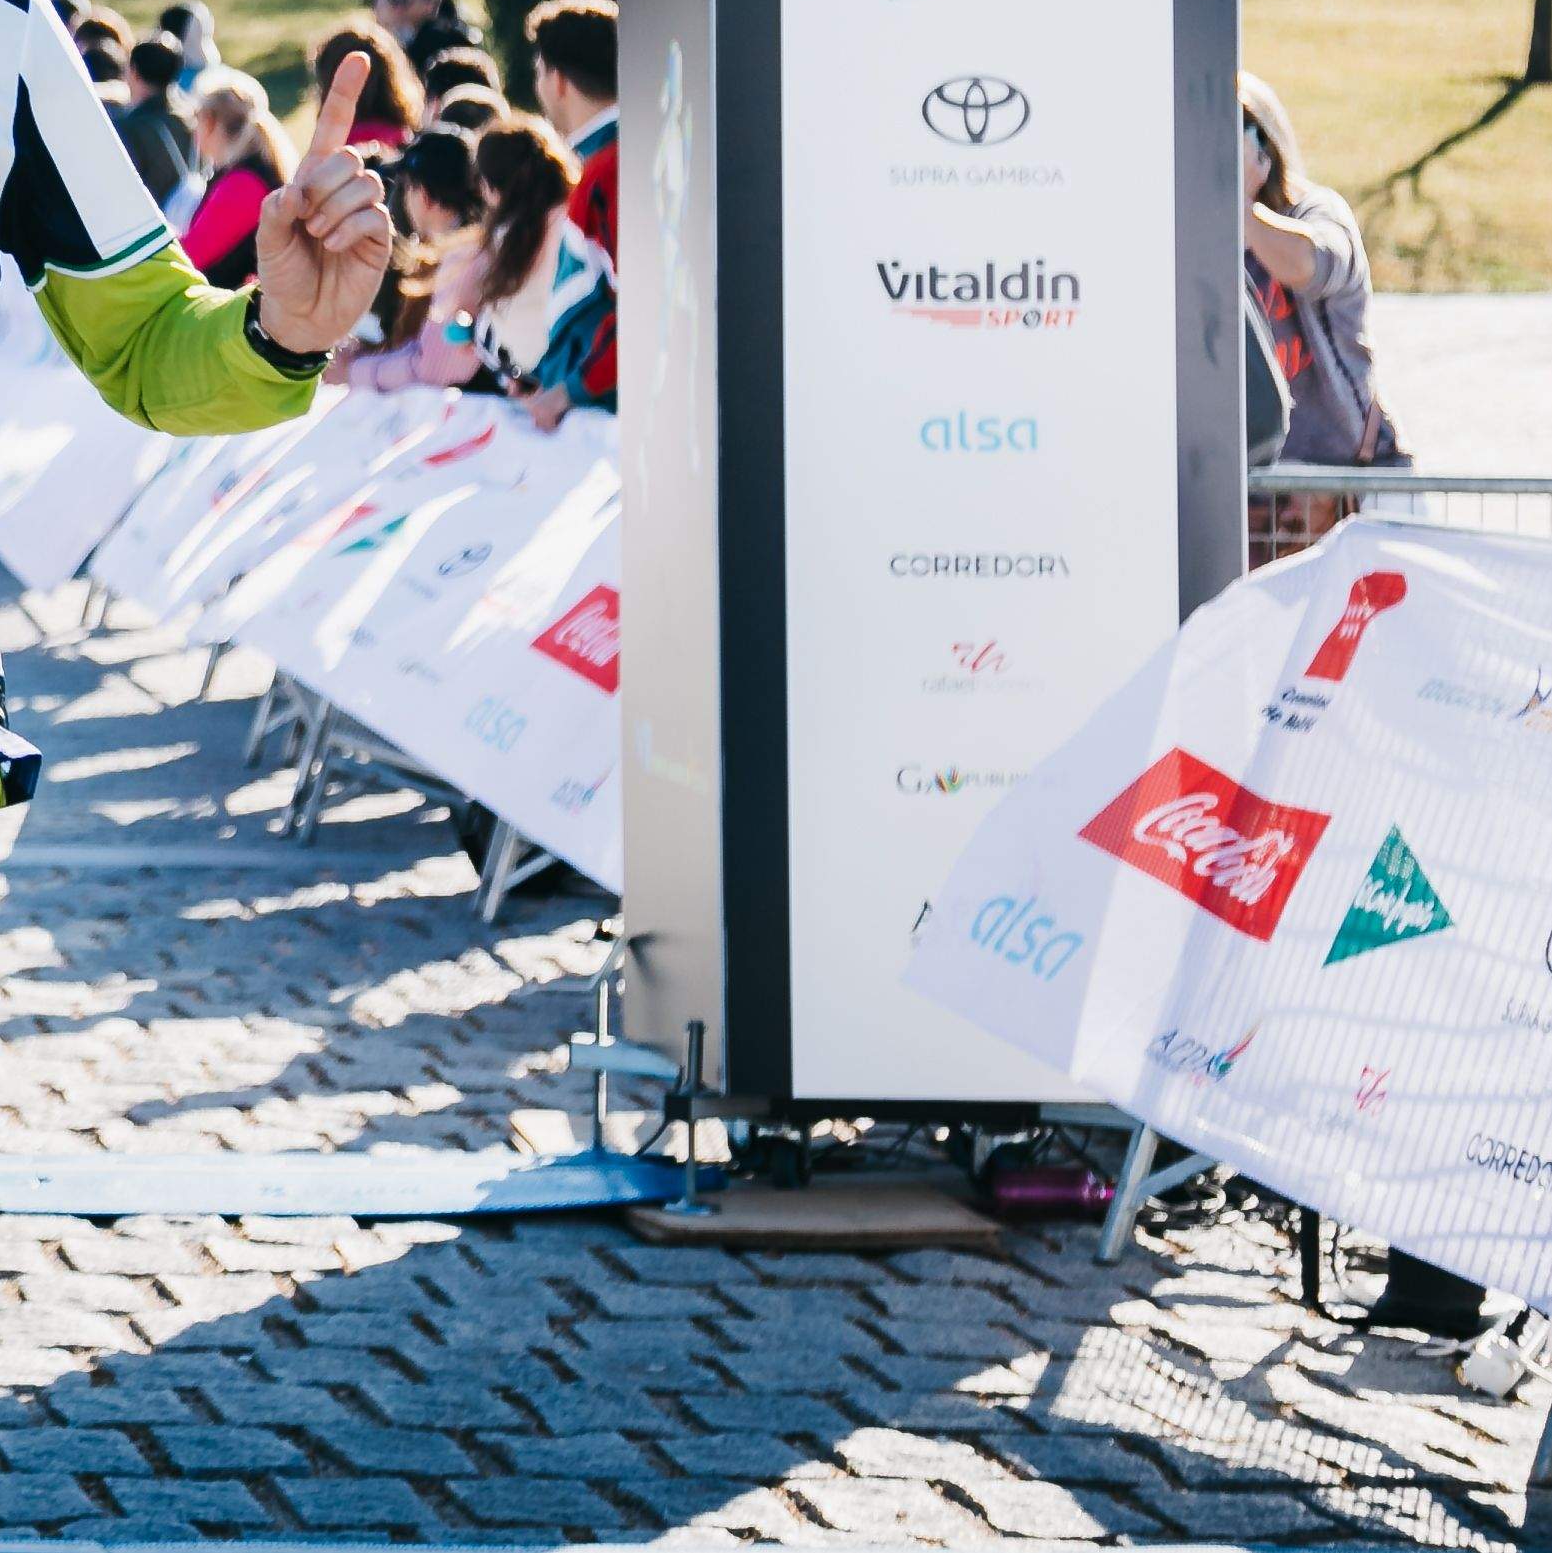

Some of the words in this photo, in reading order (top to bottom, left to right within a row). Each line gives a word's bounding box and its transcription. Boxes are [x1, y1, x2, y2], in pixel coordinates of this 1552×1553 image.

[890, 167, 959, 186] SUPRA
[966, 167, 1064, 186] GAMBOA
[876, 259, 1081, 303] Vitaldin
[986, 309, 1077, 329] SPORT
[920, 410, 1039, 452] alsa
[970, 892, 1085, 982] alsa
